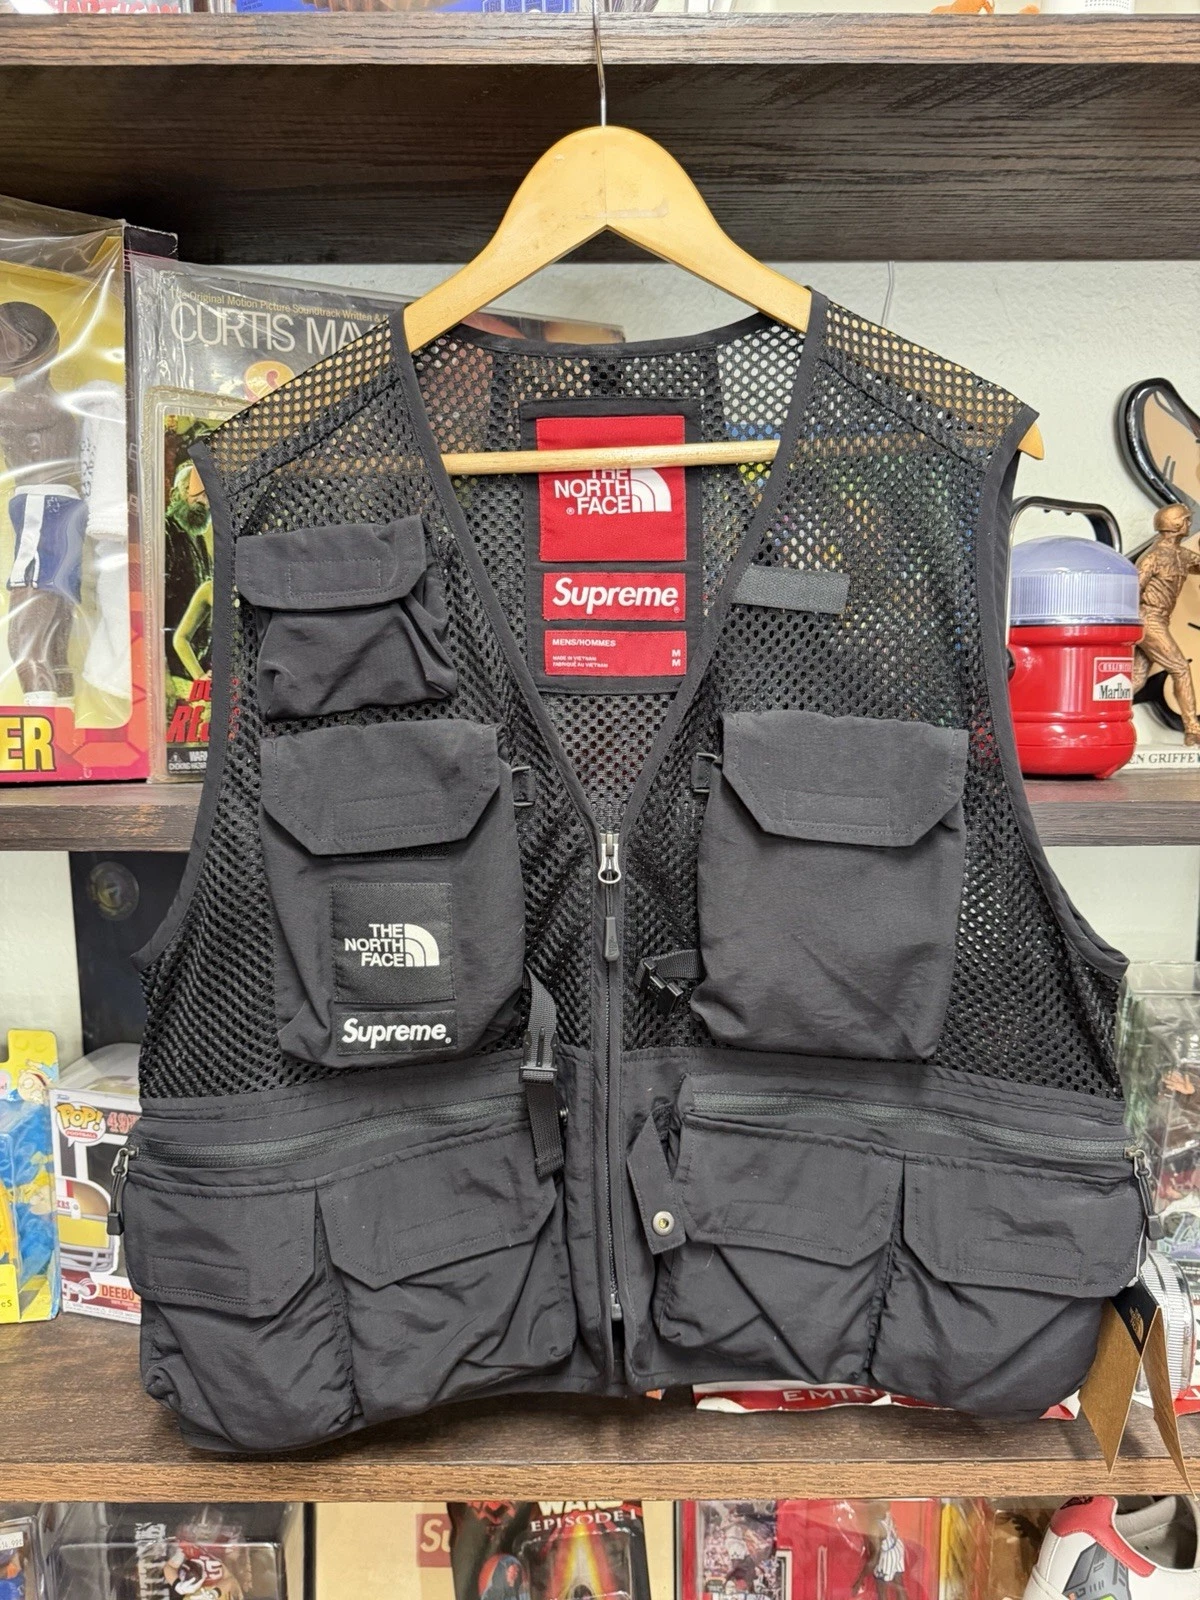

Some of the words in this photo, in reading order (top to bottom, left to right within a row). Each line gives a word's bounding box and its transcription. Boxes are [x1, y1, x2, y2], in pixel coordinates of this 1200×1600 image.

[189, 290, 225, 304] Original
[227, 295, 258, 308] Motion
[260, 300, 290, 312] Picture
[292, 304, 340, 318] Soundtrack
[341, 309, 373, 321] Written
[170, 301, 295, 353] CURTIS
[554, 479, 631, 499] NORTH
[577, 497, 631, 515] FACE
[552, 577, 679, 614] Supreme
[552, 638, 617, 647] MENS/HOMMES
[671, 649, 681, 657] M
[671, 658, 681, 667] M
[0, 715, 56, 772] ER
[369, 923, 403, 938] THE
[344, 938, 404, 952] NORTH
[361, 953, 404, 967] FACE
[342, 1018, 446, 1049] Supreme
[55, 1103, 104, 1132] POP!
[101, 1284, 135, 1301] DEEBO
[531, 1510, 624, 1532] EPISODE
[631, 1509, 638, 1520] I
